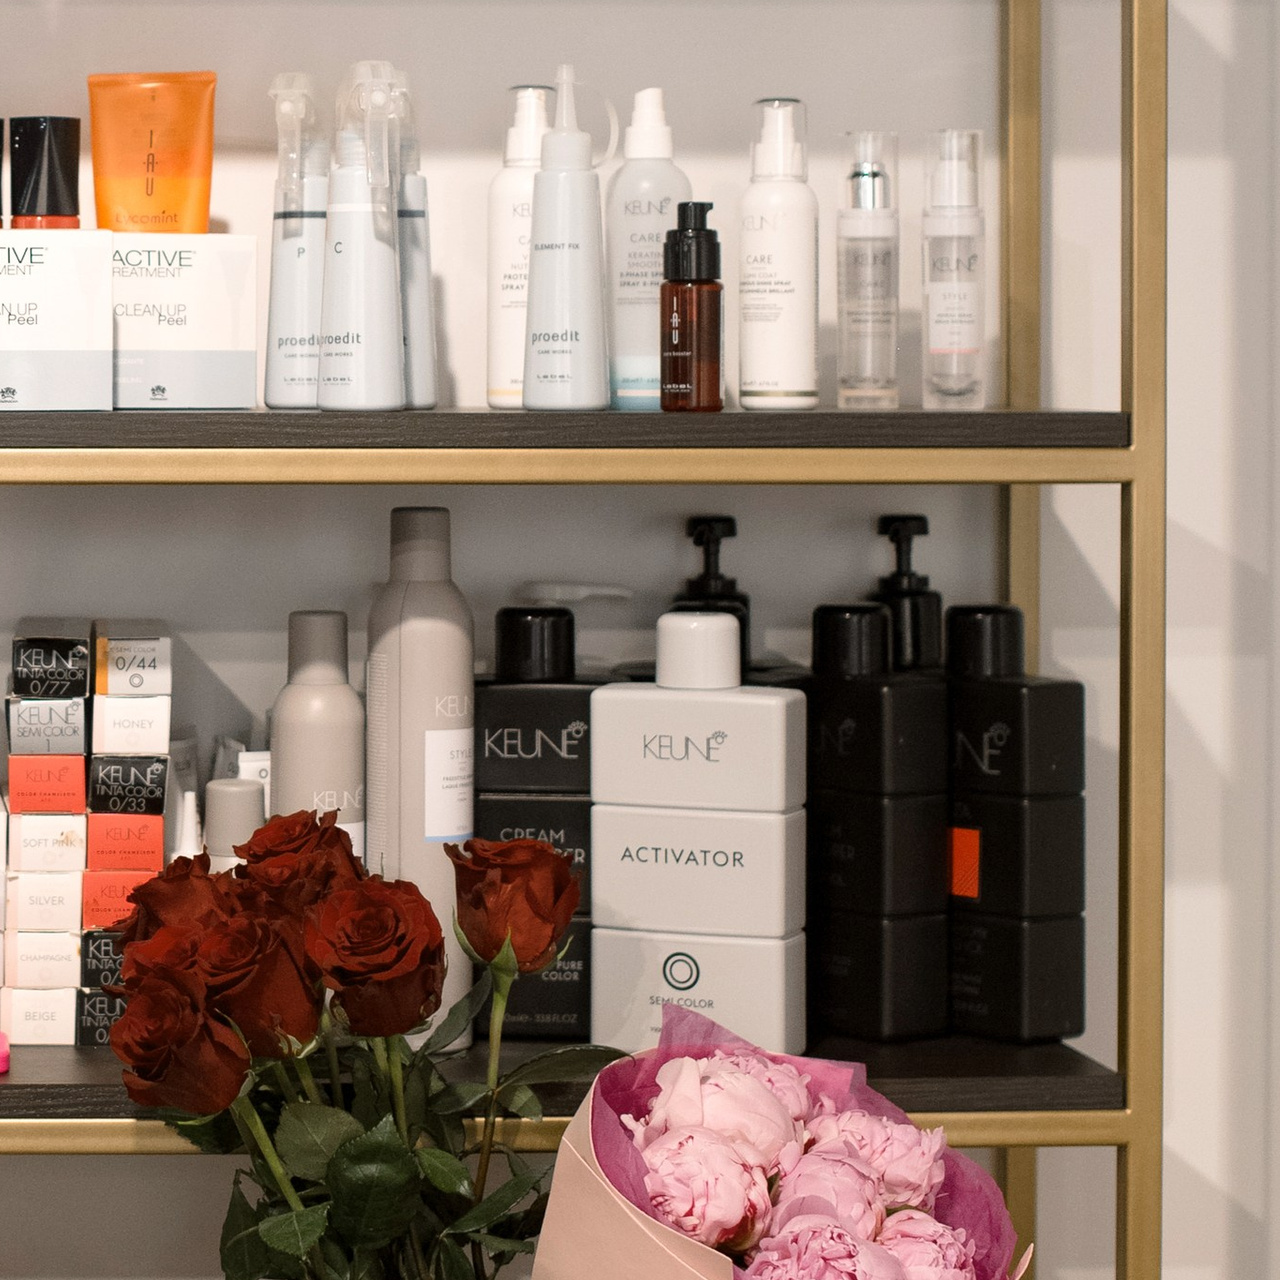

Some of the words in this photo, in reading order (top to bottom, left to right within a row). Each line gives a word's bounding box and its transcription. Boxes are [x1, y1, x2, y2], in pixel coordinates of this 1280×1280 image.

[624, 196, 671, 216] KEUNE
[630, 233, 662, 243] CARE
[334, 241, 343, 254] C
[568, 242, 579, 250] FIX
[297, 247, 305, 258] P
[113, 250, 193, 267] ACTIVE
[746, 255, 773, 265] CARE
[113, 267, 182, 277] REATMENT
[17, 303, 37, 315] UP
[114, 304, 163, 317] CLEAN
[167, 304, 187, 316] UP
[7, 314, 38, 325] Peel
[158, 314, 187, 325] Peel
[531, 329, 579, 346] proedit
[20, 645, 88, 669] KEUNE
[115, 655, 157, 672] 0/44
[17, 668, 45, 679] TINTA
[46, 669, 84, 680] COLOR
[30, 680, 70, 696] 0/77
[113, 719, 154, 729] HONEY
[485, 720, 588, 760] KEUNE
[643, 730, 728, 762] KEUNE
[23, 838, 50, 848] SOFT
[621, 847, 744, 868] ACTIVATOR
[29, 896, 64, 906] SILVER
[20, 953, 72, 962] CHAMPAGNE
[556, 961, 583, 971] PURE
[542, 972, 579, 981] COLOR
[680, 997, 715, 1009] COLOR
[25, 1011, 57, 1021] BEIGE
